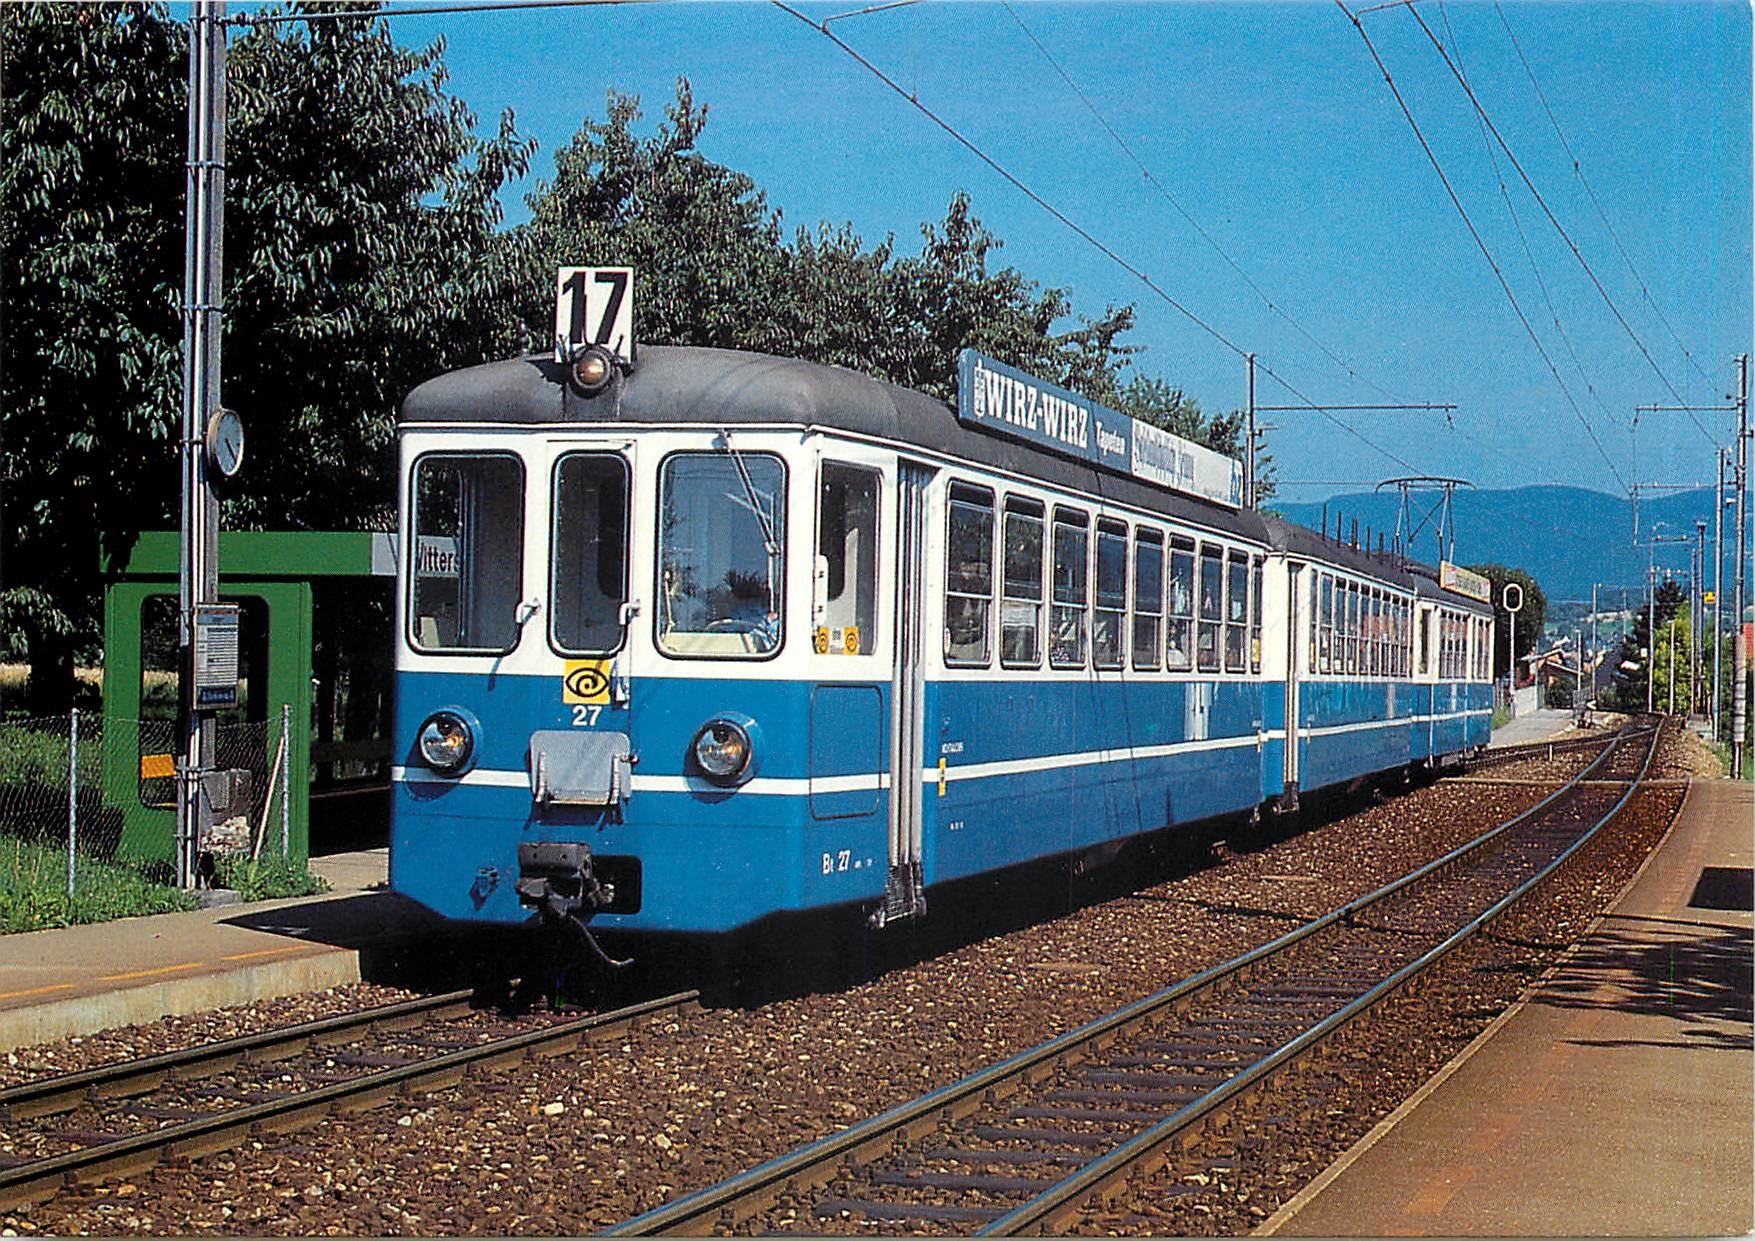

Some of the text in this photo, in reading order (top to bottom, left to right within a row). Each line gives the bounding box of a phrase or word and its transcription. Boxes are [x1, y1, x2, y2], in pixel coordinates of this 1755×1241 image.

[562, 271, 629, 344] 17
[985, 368, 1088, 449] WIRZ-WIRZ
[572, 705, 602, 726] 27
[838, 849, 851, 871] 27
